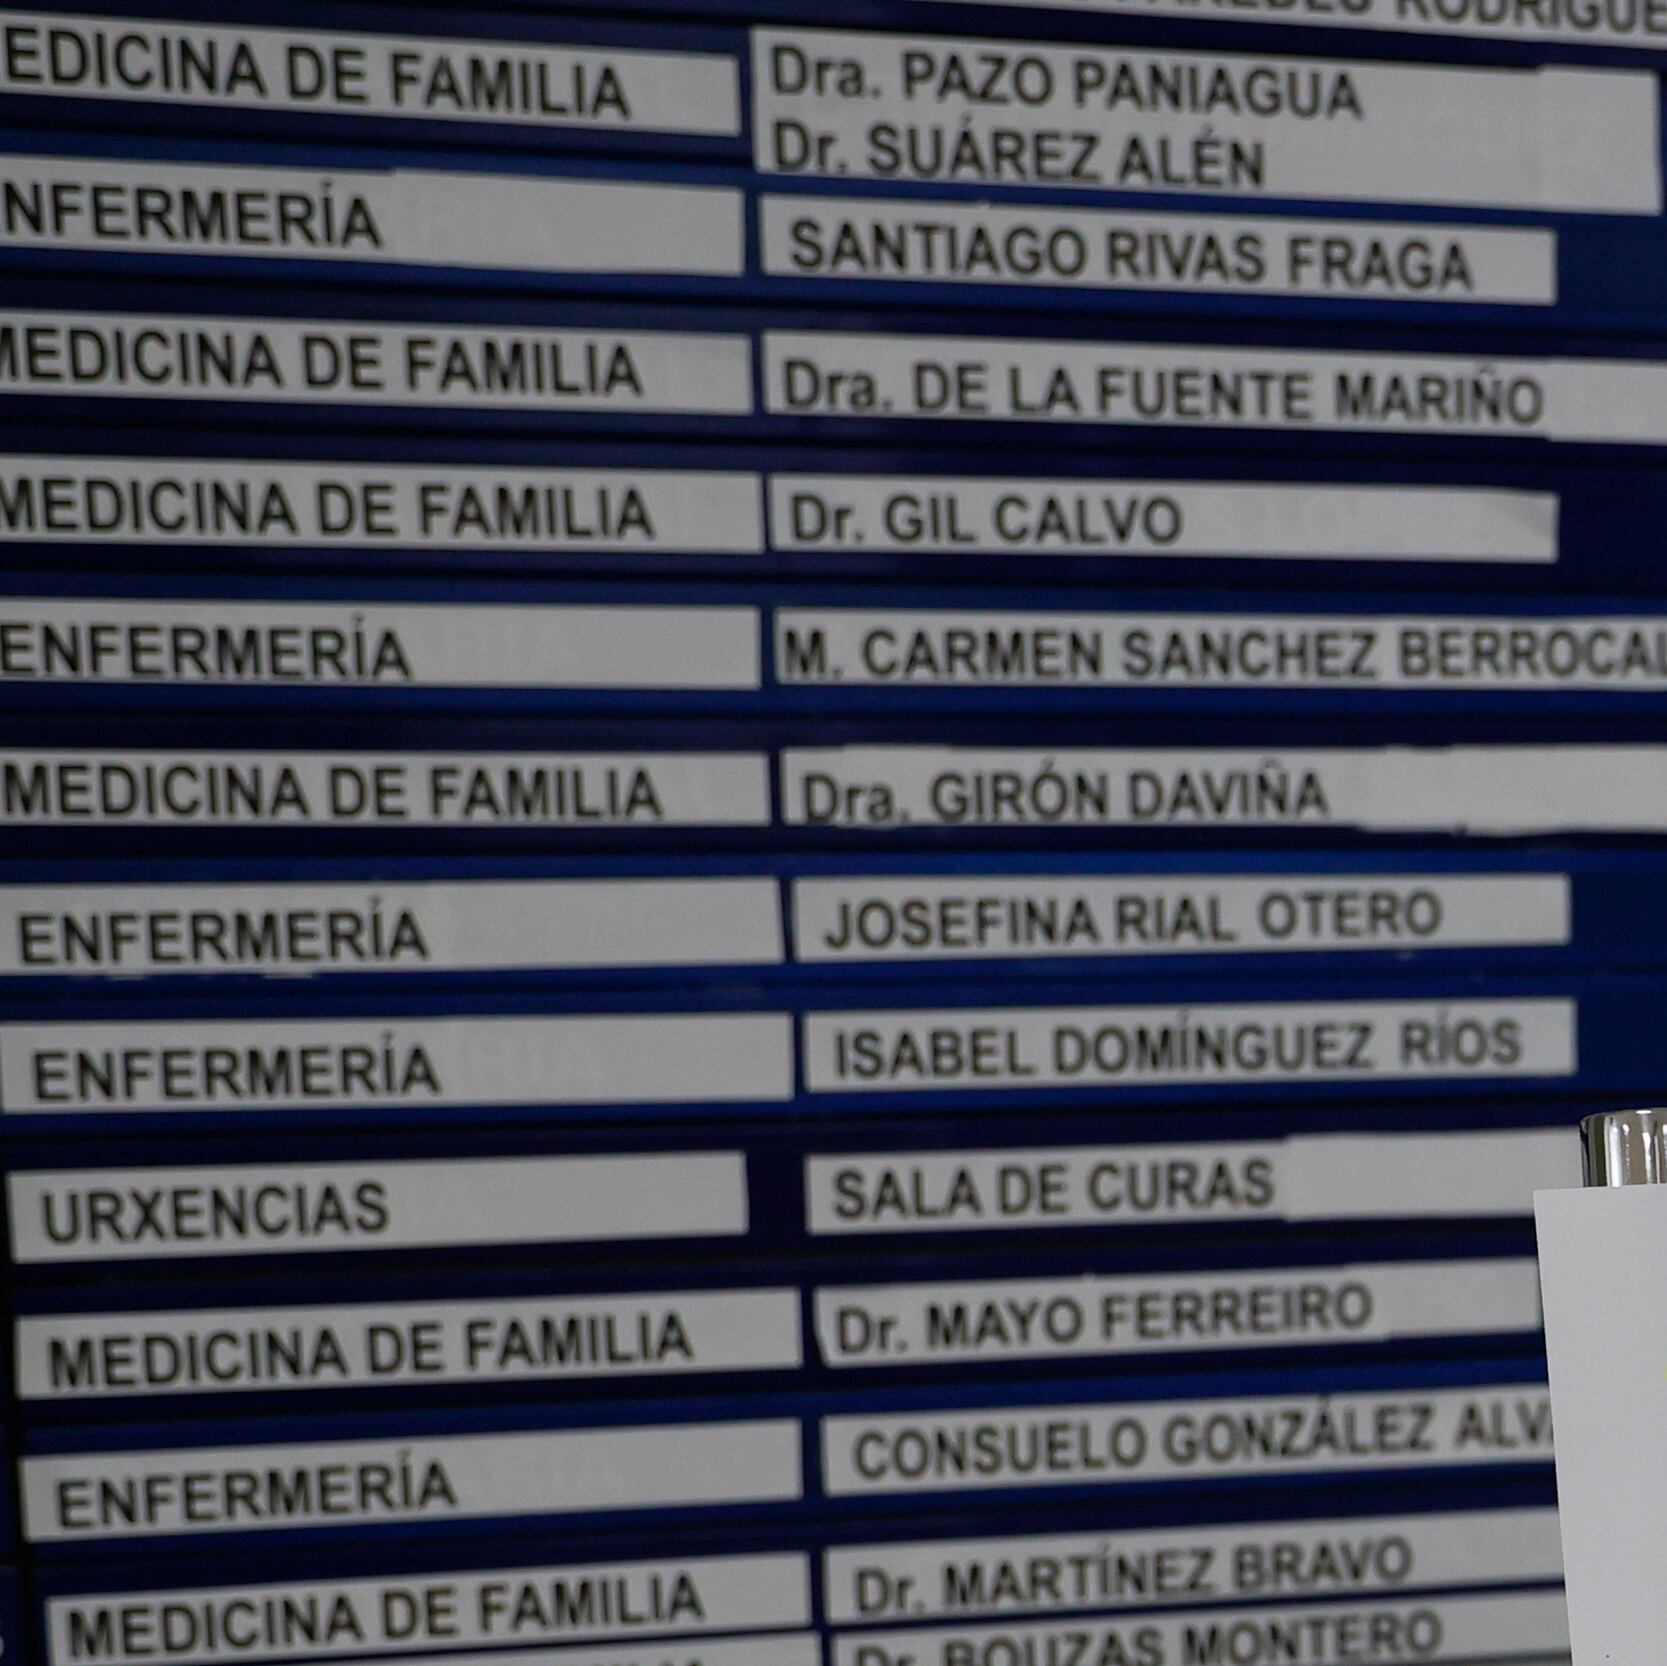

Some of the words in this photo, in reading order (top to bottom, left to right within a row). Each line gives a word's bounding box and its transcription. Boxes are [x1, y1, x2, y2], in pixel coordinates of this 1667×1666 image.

[770, 47, 880, 101] Dra.
[902, 52, 1053, 107] PAZO
[1075, 58, 1364, 122] PANIAGUA
[772, 120, 847, 174] Dr.
[869, 117, 1101, 185] SUÁREZ
[1118, 126, 1265, 190] ALÉN
[791, 219, 1086, 278] SANTIAGO
[1107, 227, 1266, 284] RIVAS
[1287, 236, 1472, 293] FRAGA
[784, 360, 894, 413] Dra.
[914, 362, 988, 413] DE
[1008, 365, 1083, 416] LA
[1097, 366, 1313, 422] FUENTE
[1336, 361, 1545, 427] MARIÑO
[791, 493, 864, 544] Dr.
[884, 494, 977, 544] GIL
[995, 495, 1183, 547] CALVO
[784, 629, 845, 681] M.
[861, 628, 1101, 681] CARMEN
[1123, 628, 1376, 682] SANCHEZ
[4, 763, 309, 818] MEDICINA
[331, 766, 408, 818] DE
[429, 767, 663, 820] FAMILIA
[803, 773, 908, 826] Dra.
[930, 761, 1110, 825] GIRÓN
[1130, 761, 1329, 821] DAVIÑA
[19, 898, 430, 965] ENFERMERÍA
[825, 896, 1099, 952] JOSEFINA
[1115, 895, 1235, 944] RIAL
[1259, 889, 1442, 939] OTERO
[33, 1034, 442, 1103] ENFERMERÍA
[836, 1027, 1035, 1080] ISABEL
[1053, 1012, 1374, 1074] DOMÍNGUEZ
[1402, 1009, 1521, 1069] RÍOS
[42, 1181, 389, 1244] URXENCIAS
[835, 1168, 983, 1222] SALA
[1000, 1165, 1068, 1216] DE
[1087, 1158, 1276, 1209] CURAS
[49, 1326, 349, 1391] MEDICINA
[367, 1323, 444, 1375] DE
[465, 1311, 694, 1369] FAMILIA
[837, 1307, 908, 1354] Dr.
[927, 1296, 1083, 1350] MAYO
[1103, 1283, 1373, 1342] FERREIRO
[854, 1414, 1147, 1480] CONSUELO
[1164, 1397, 1433, 1464] GONZÁLEZ
[57, 1453, 457, 1530] ENFERMERÍA
[856, 1567, 927, 1615] Dr.
[945, 1544, 1216, 1607] MARTÍNEZ
[1234, 1536, 1413, 1591] BRAVO
